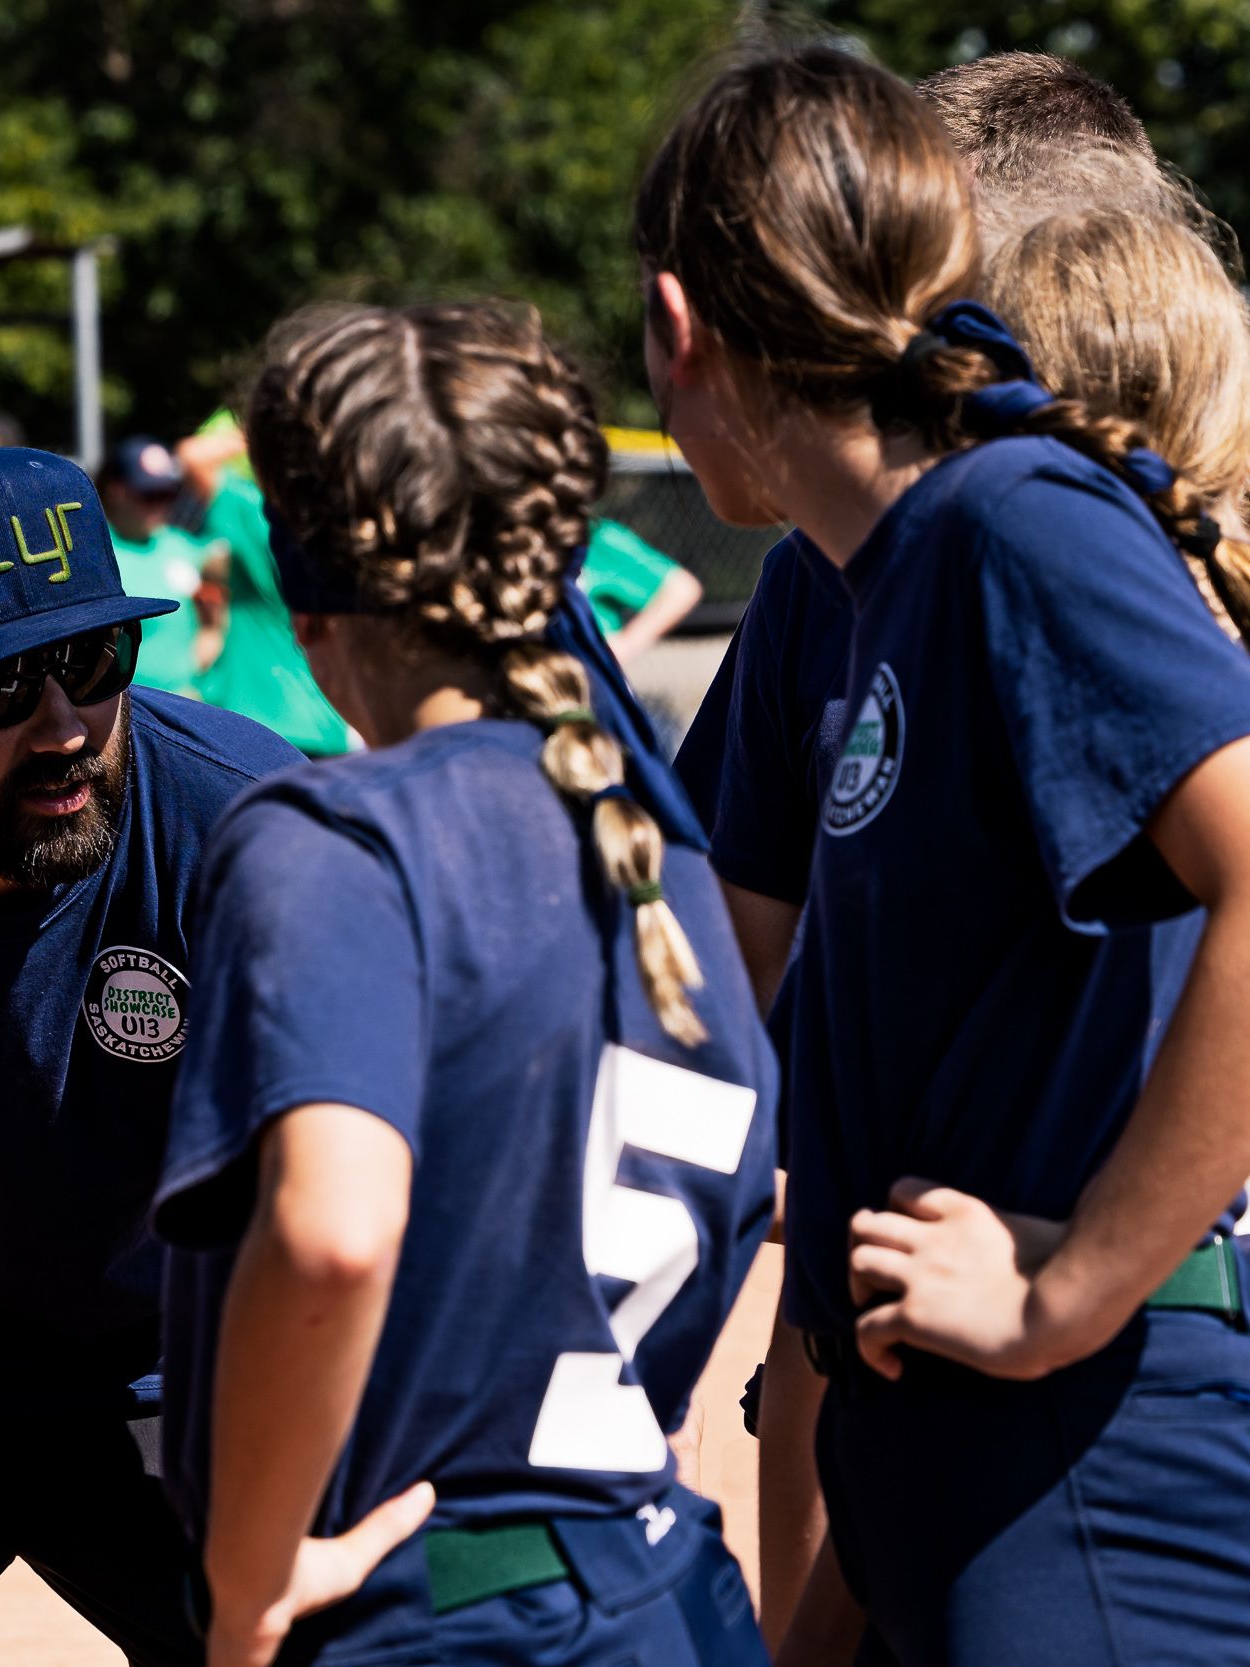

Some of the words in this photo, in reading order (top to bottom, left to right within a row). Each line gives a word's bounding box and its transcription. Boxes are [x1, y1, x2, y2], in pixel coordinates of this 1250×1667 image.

[100, 954, 178, 990] SOFTBALL
[108, 986, 171, 1007] DISTRICT
[104, 998, 177, 1019] SHOWCASE
[121, 1015, 160, 1038] U13
[528, 1043, 757, 1473] 5
